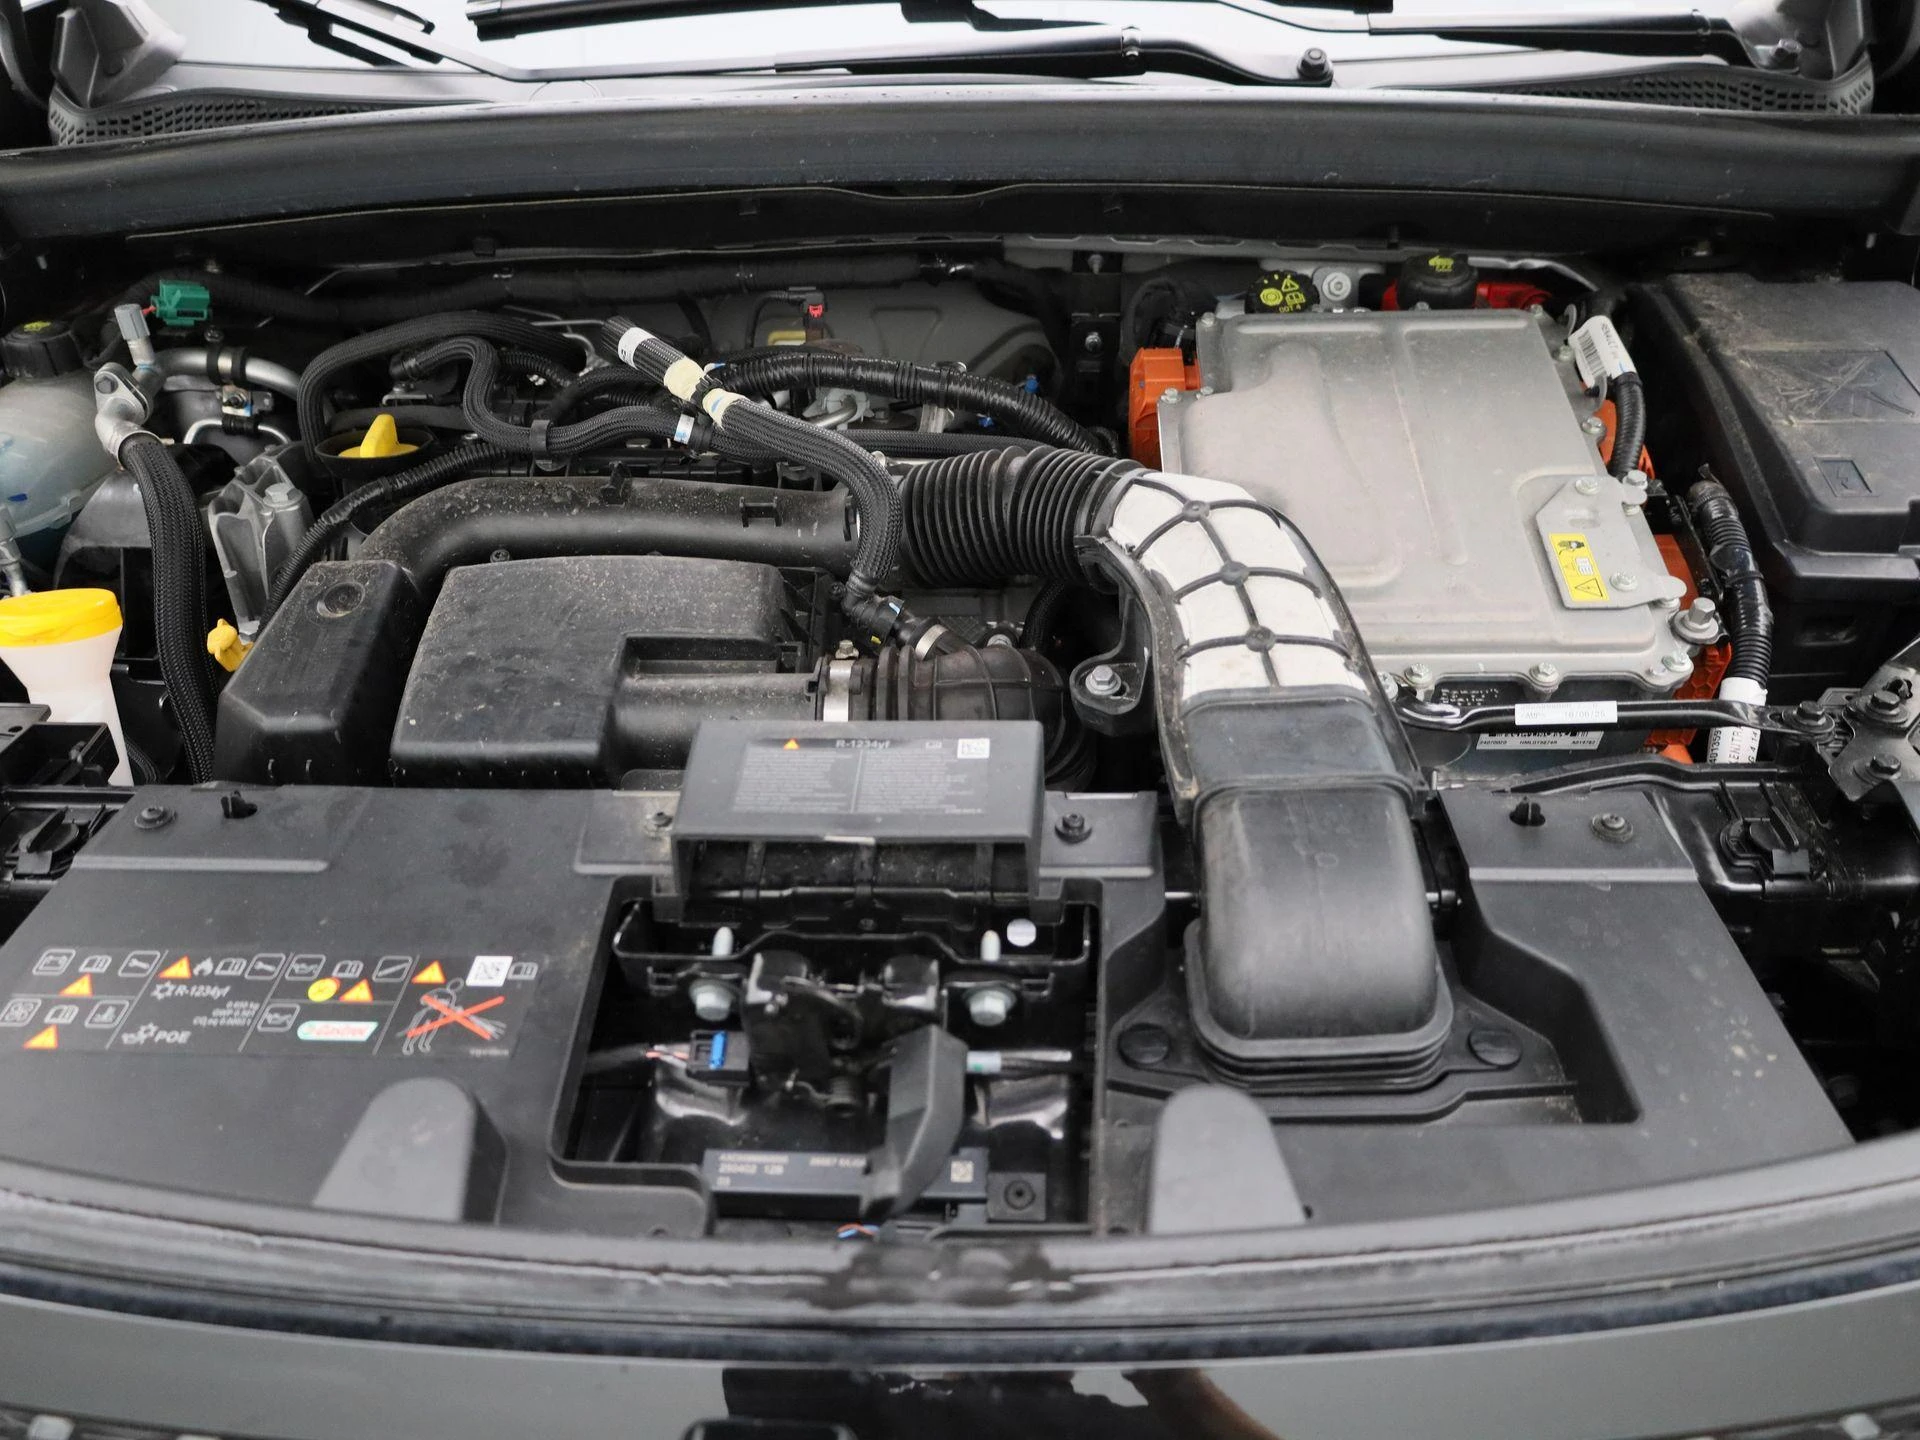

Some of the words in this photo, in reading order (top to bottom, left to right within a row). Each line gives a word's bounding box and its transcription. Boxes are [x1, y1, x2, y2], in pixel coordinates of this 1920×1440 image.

[835, 739, 890, 749] R-1234yf
[174, 984, 231, 1000] R-1234yf
[154, 1030, 192, 1044] POE
